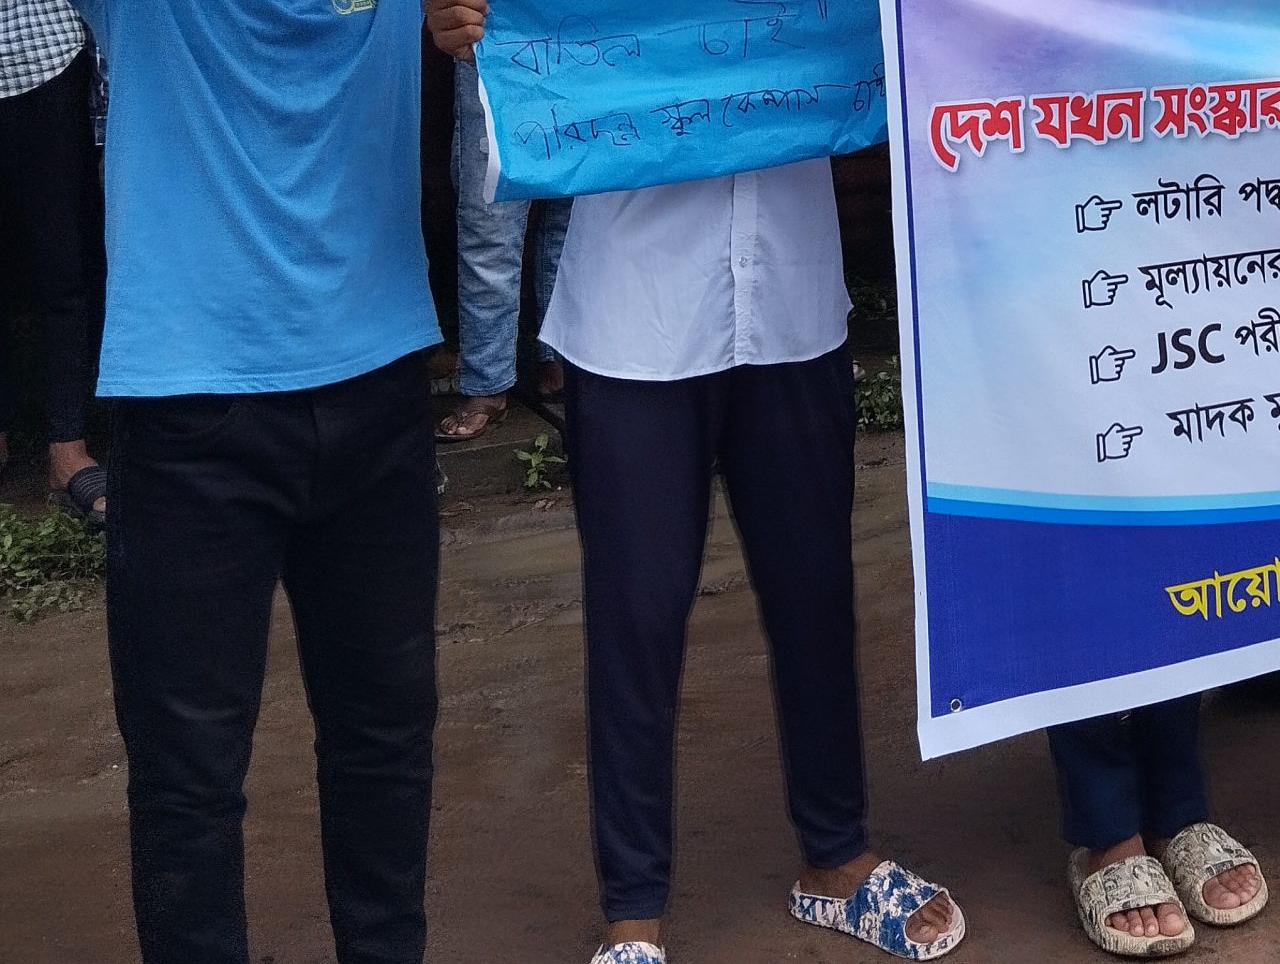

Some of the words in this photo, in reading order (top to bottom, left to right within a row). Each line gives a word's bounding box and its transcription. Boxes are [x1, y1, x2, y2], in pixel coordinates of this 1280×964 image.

[494, 14, 642, 76] বাতিল
[930, 99, 1023, 169] দেশ
[1032, 91, 1144, 146] যখন
[1132, 174, 1226, 225] লটারি
[1151, 323, 1227, 375] JSC
[1166, 397, 1255, 444] মাদক
